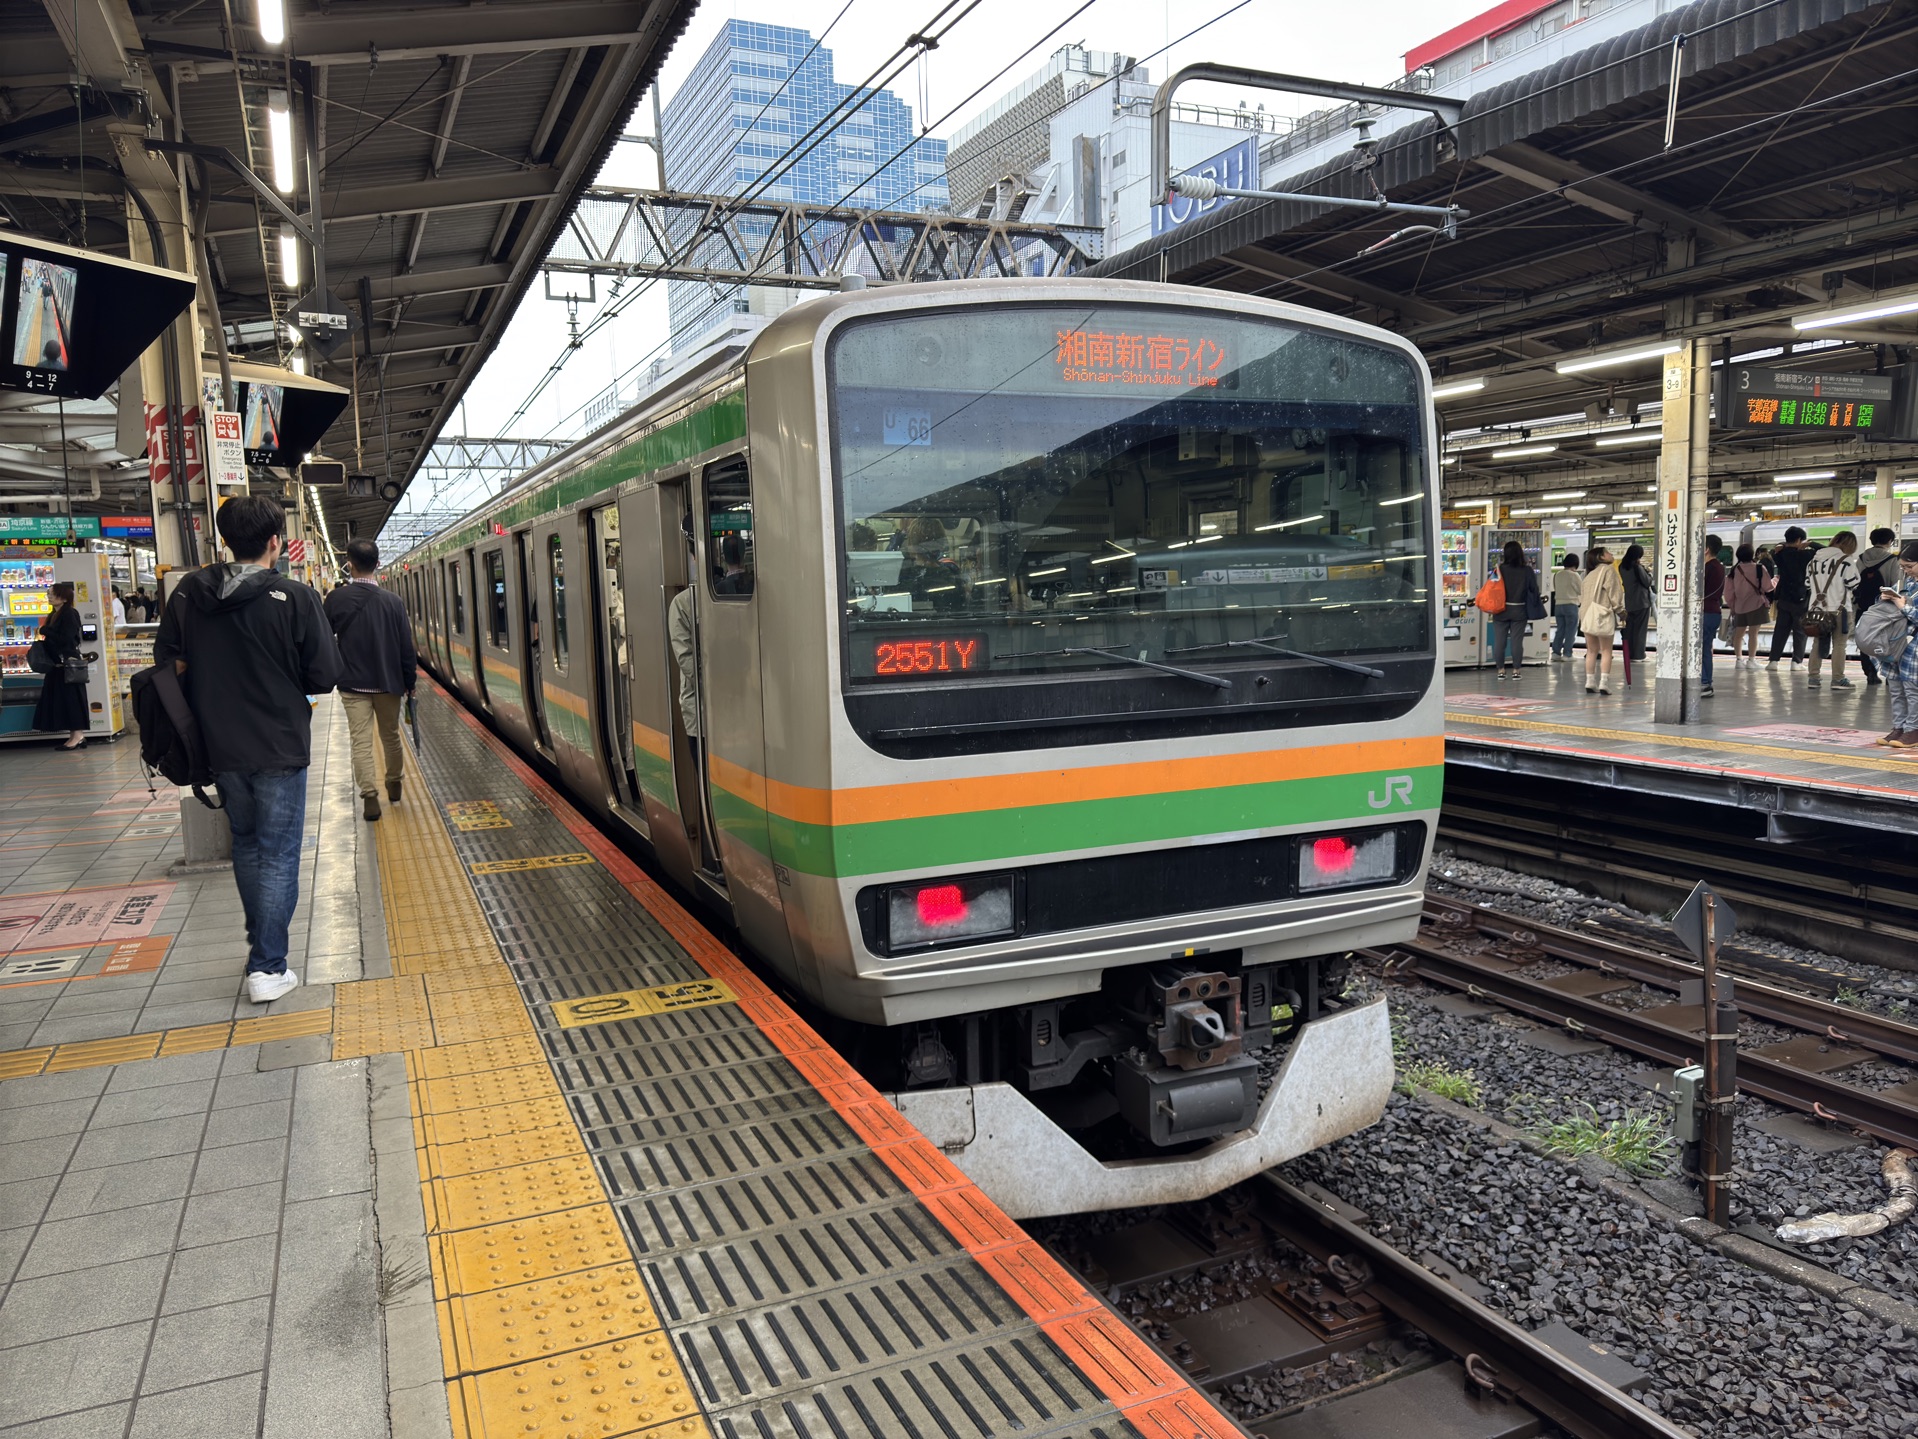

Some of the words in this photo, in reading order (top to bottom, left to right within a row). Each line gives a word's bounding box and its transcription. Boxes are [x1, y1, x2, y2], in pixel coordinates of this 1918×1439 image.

[1056, 329, 1225, 372] 湘南新宿ライン
[25, 370, 32, 379] 9
[47, 373, 57, 382] 12
[1188, 372, 1218, 387] Line
[1741, 370, 1750, 390] 3
[1774, 372, 1814, 384] 湘南新宿ライン
[27, 380, 33, 389] 4
[48, 382, 54, 391] 7
[1747, 398, 1779, 412] 宇都宮線
[1781, 400, 1797, 413] 普通
[1801, 401, 1828, 414] 16:46
[215, 415, 238, 424] STOP
[1748, 411, 1774, 423] 高崎線
[1779, 412, 1795, 425] 普通
[1800, 413, 1826, 425] 16:56
[885, 413, 895, 429] U
[908, 417, 930, 441] 66
[163, 431, 193, 440] SP
[216, 441, 241, 449] 非常停止
[223, 449, 242, 457] ボタン
[1667, 513, 1678, 570] いけぶくろ
[876, 640, 975, 673] 2551Y
[1368, 775, 1413, 809] JR
[655, 983, 723, 1007] 15
[569, 998, 635, 1020] 10
